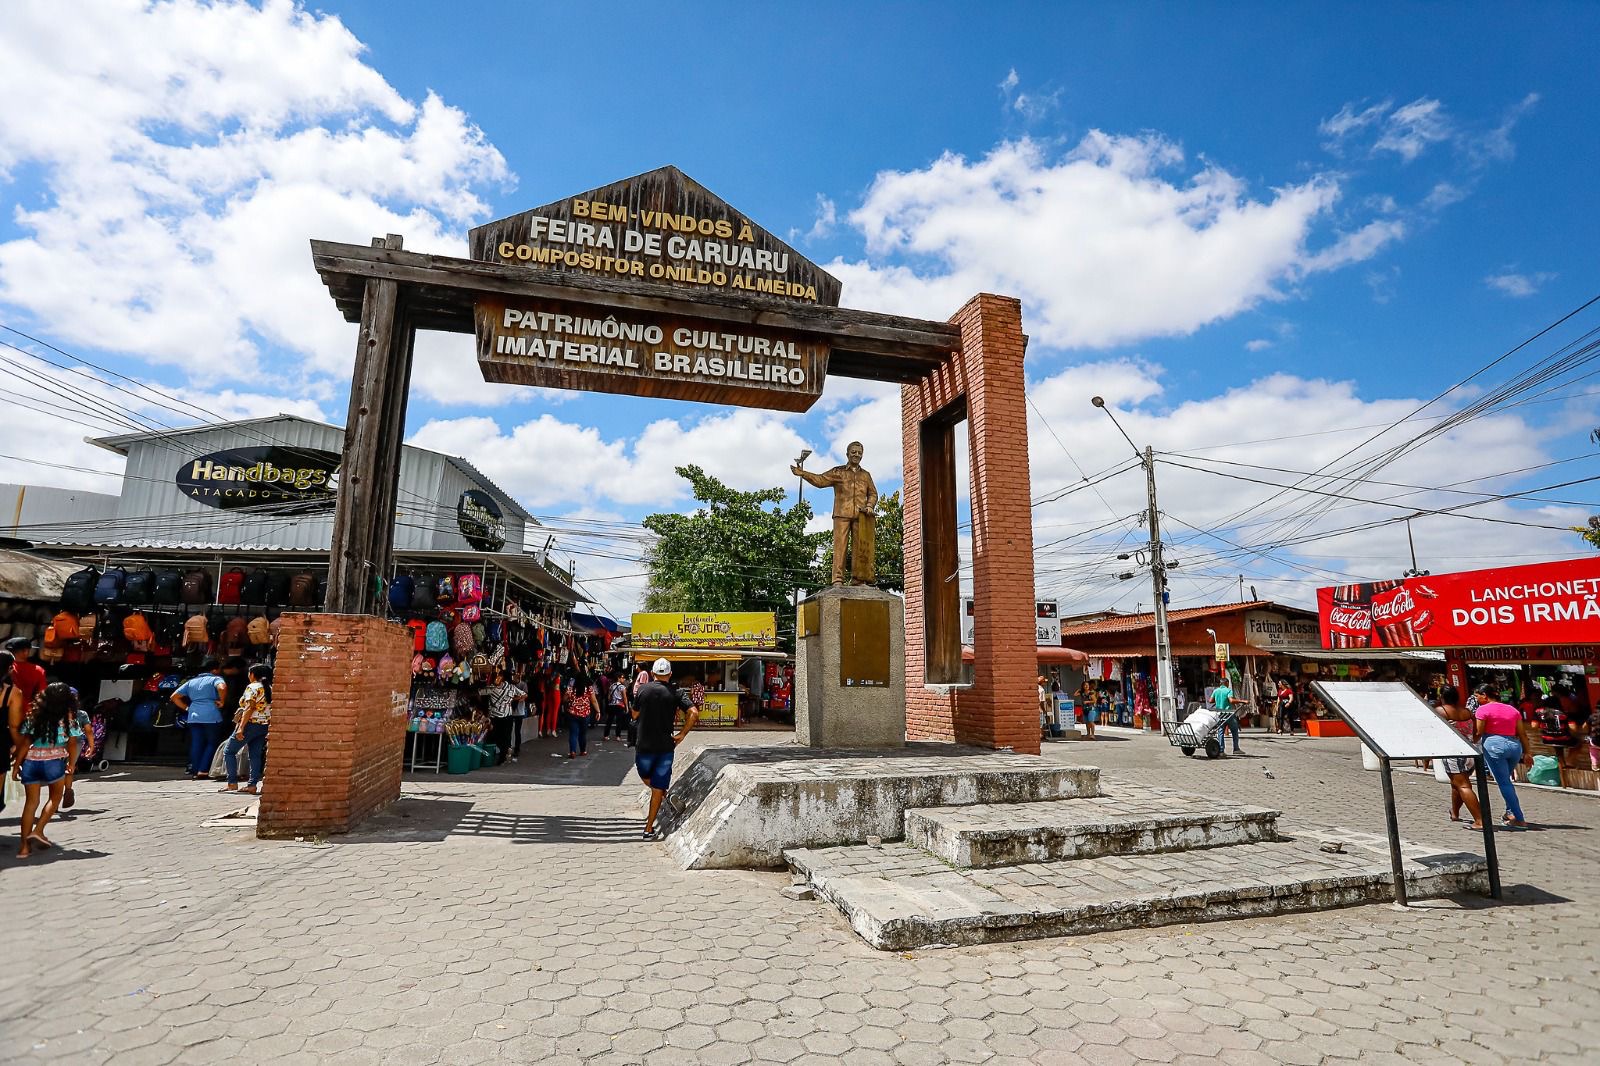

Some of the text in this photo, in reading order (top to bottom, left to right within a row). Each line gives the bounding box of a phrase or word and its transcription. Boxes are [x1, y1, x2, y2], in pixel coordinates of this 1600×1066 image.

[573, 199, 755, 242] BEM-VINDOS À
[530, 216, 790, 273] FEIRA DE CARUARU
[498, 241, 817, 301] COMPOSITOR ONILDO ALMEIDA
[503, 308, 801, 360] PATRIMÔNIO CULTURAL
[496, 336, 806, 385] IMATERIAL BRASILEIRO
[192, 460, 327, 490] Handbags
[191, 488, 271, 498] ATACADO
[1371, 590, 1415, 621] Coca-Cola
[1470, 577, 1600, 603] LANCHONET
[1250, 619, 1283, 633] Fátima
[1452, 605, 1515, 627] DOIS
[1523, 593, 1600, 623] IRMÃ
